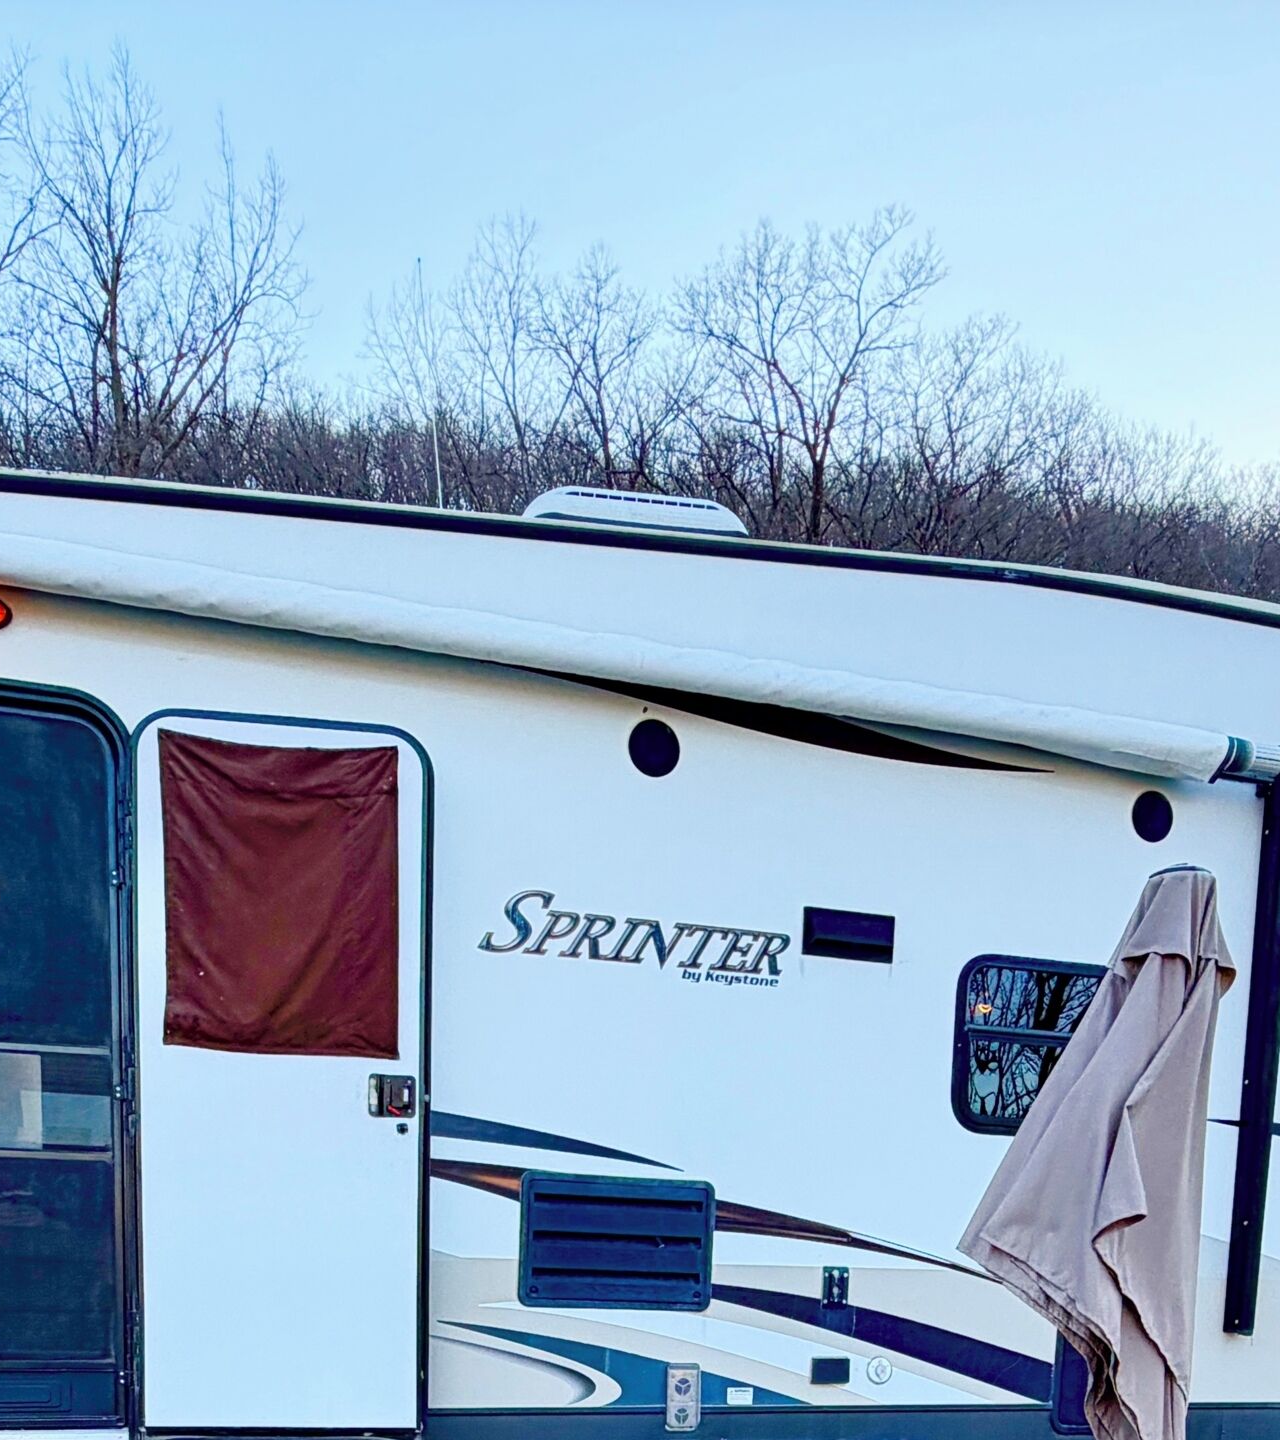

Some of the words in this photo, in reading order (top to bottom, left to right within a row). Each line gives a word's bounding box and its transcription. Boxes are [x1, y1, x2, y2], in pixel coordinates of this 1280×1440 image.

[477, 889, 791, 976] SPRINTER
[681, 969, 702, 983] by
[705, 971, 780, 988] Keystone
